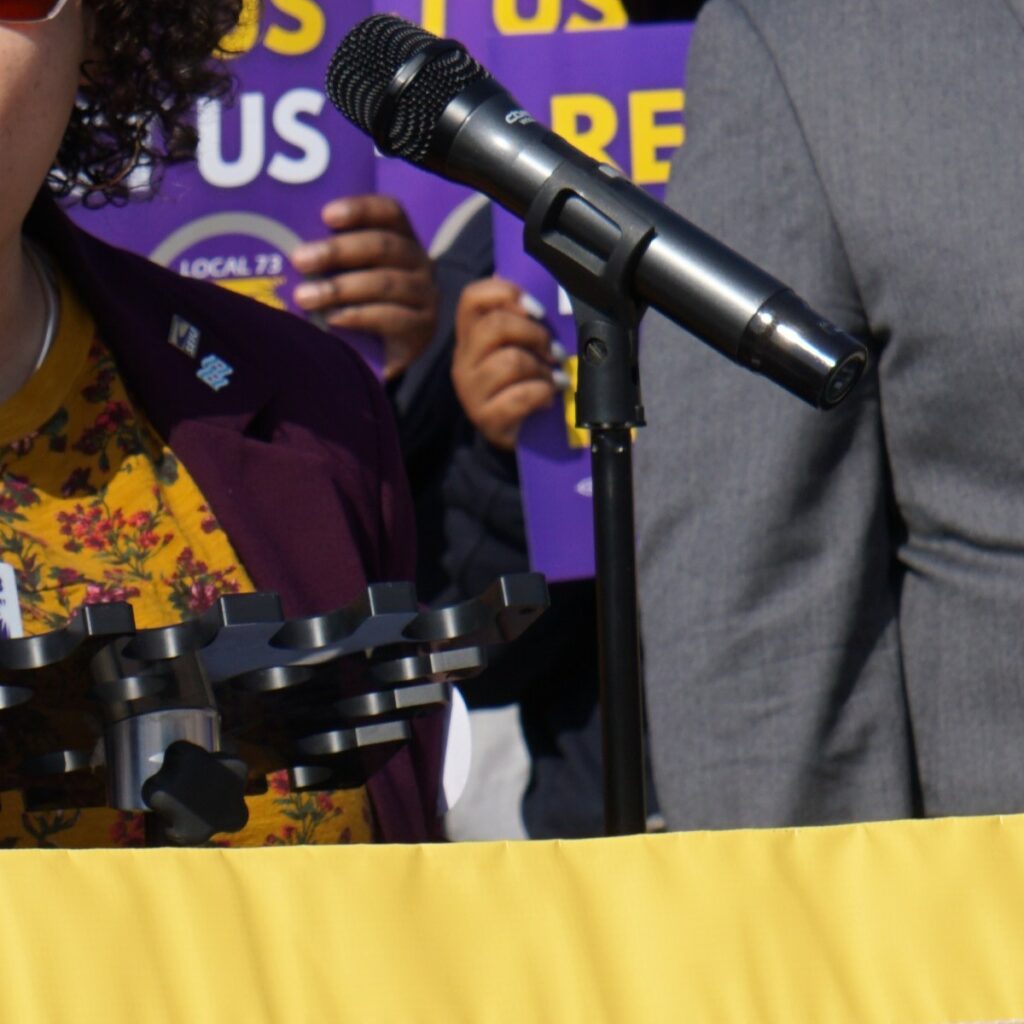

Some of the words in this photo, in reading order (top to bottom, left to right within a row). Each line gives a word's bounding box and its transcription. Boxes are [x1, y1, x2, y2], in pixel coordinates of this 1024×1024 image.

[196, 88, 331, 188] US
[179, 255, 251, 279] LOCAL
[255, 252, 283, 276] 73
